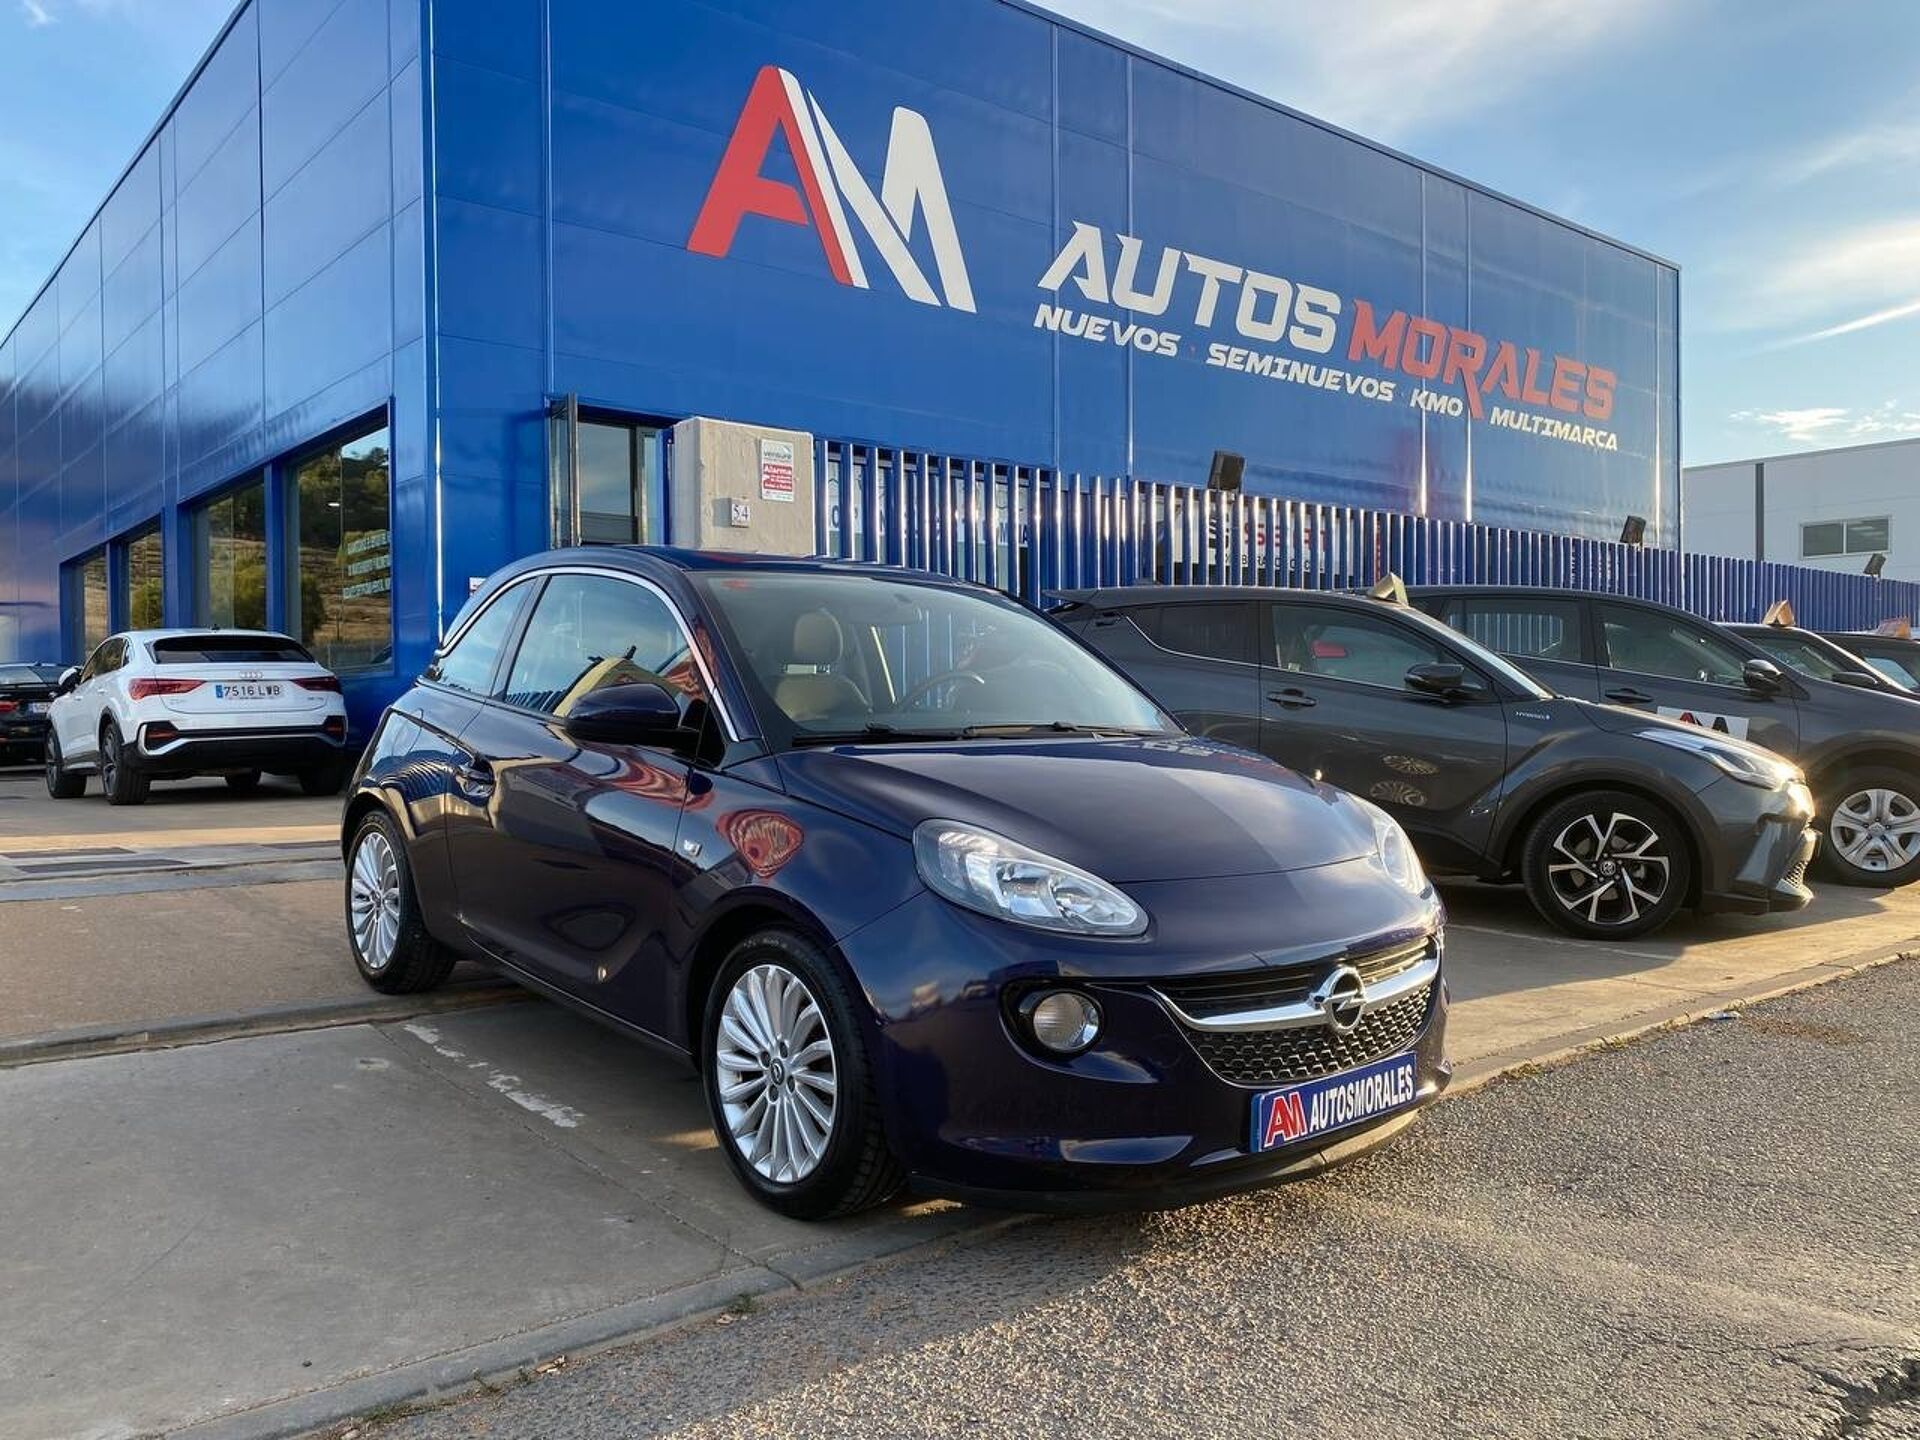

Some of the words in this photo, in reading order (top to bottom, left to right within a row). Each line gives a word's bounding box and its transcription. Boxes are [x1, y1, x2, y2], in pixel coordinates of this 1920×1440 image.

[686, 64, 977, 314] AM
[1033, 303, 1181, 357] NUEVOS
[1206, 343, 1397, 402] SEMINUEVOS
[1490, 407, 1618, 452] MULTIMARCA
[1037, 219, 1342, 354] AUTOS
[1347, 298, 1617, 421] MORALES
[223, 684, 255, 697] 7516
[1264, 1092, 1309, 1148] AM
[1309, 1063, 1414, 1133] AUTOSMORALES
